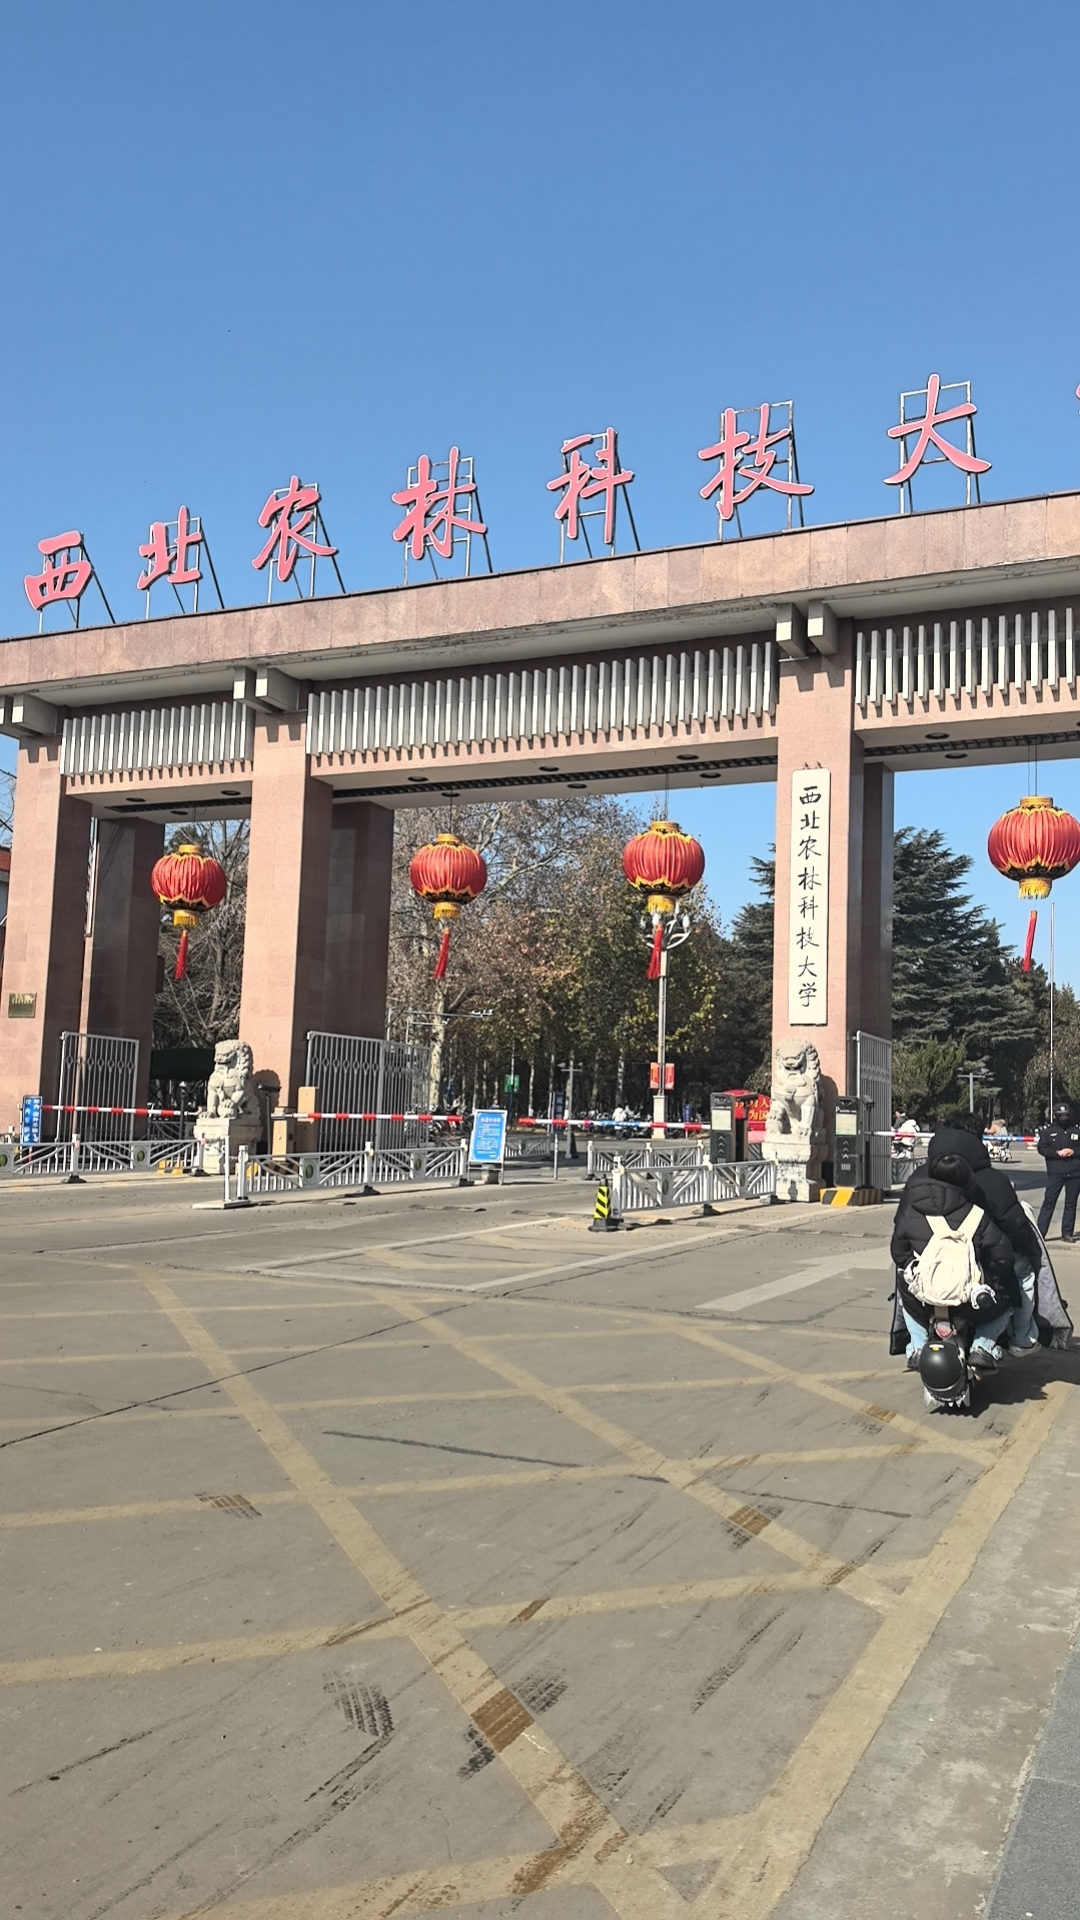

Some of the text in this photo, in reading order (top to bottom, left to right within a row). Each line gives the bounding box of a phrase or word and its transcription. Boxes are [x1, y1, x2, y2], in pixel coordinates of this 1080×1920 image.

[24, 374, 1080, 610] 西北农林科技大
[796, 785, 822, 1008] 西北农林科技大学
